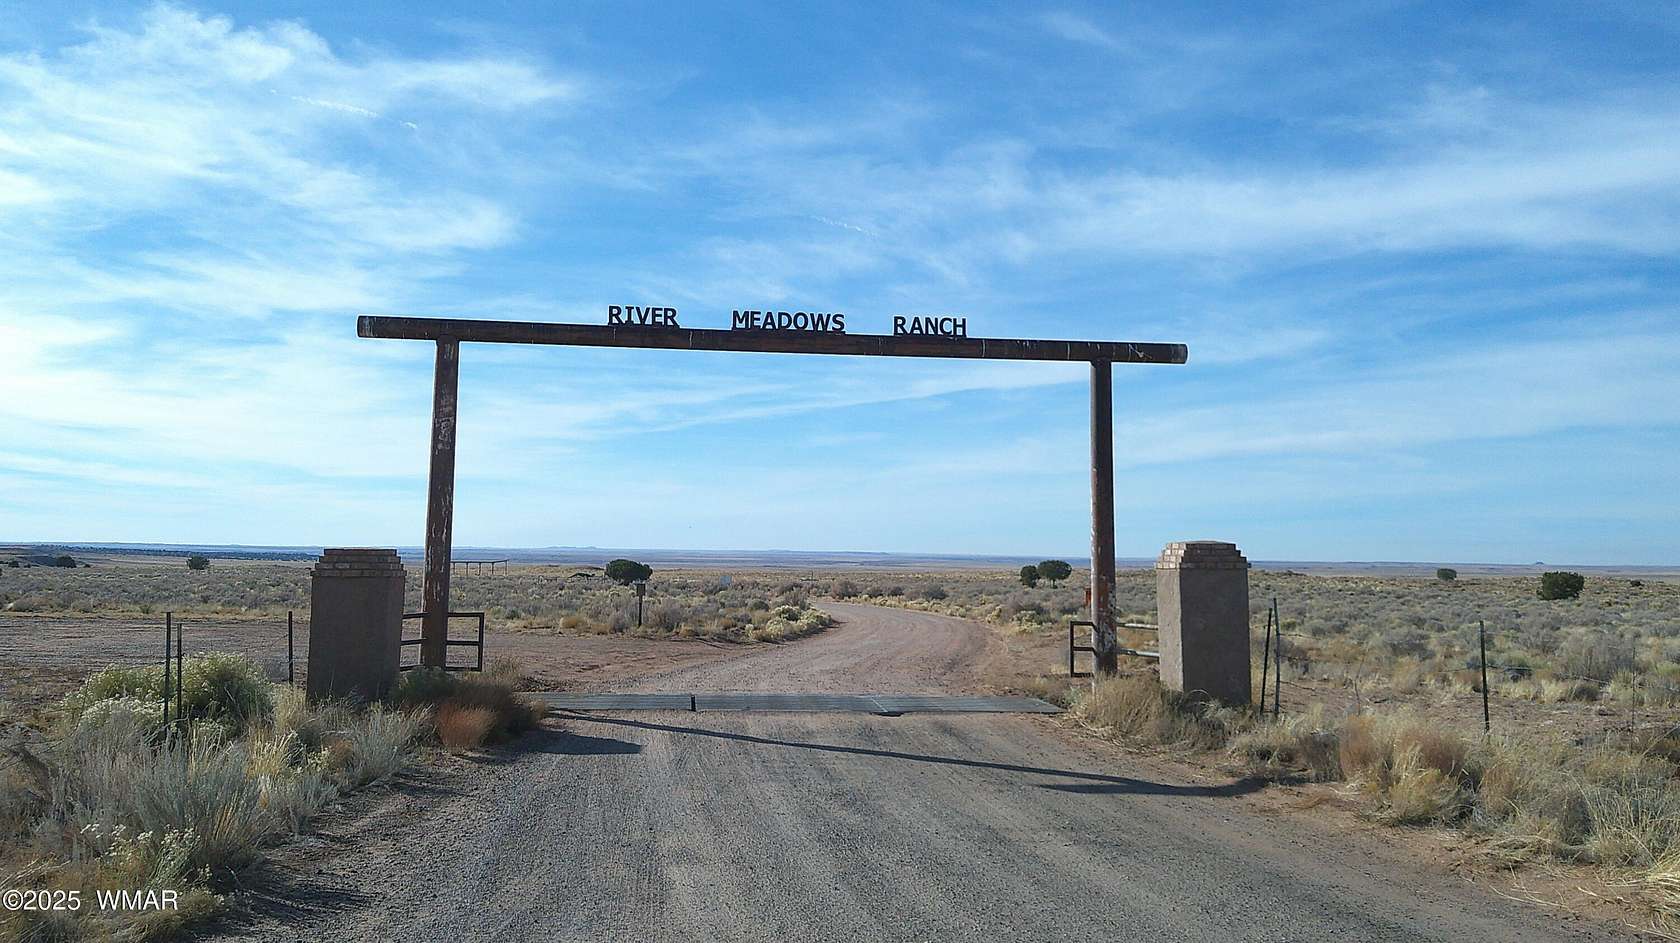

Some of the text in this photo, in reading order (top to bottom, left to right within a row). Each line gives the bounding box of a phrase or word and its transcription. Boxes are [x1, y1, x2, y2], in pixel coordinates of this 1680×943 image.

[608, 305, 967, 337] RIVER MEADOWS RANCH
